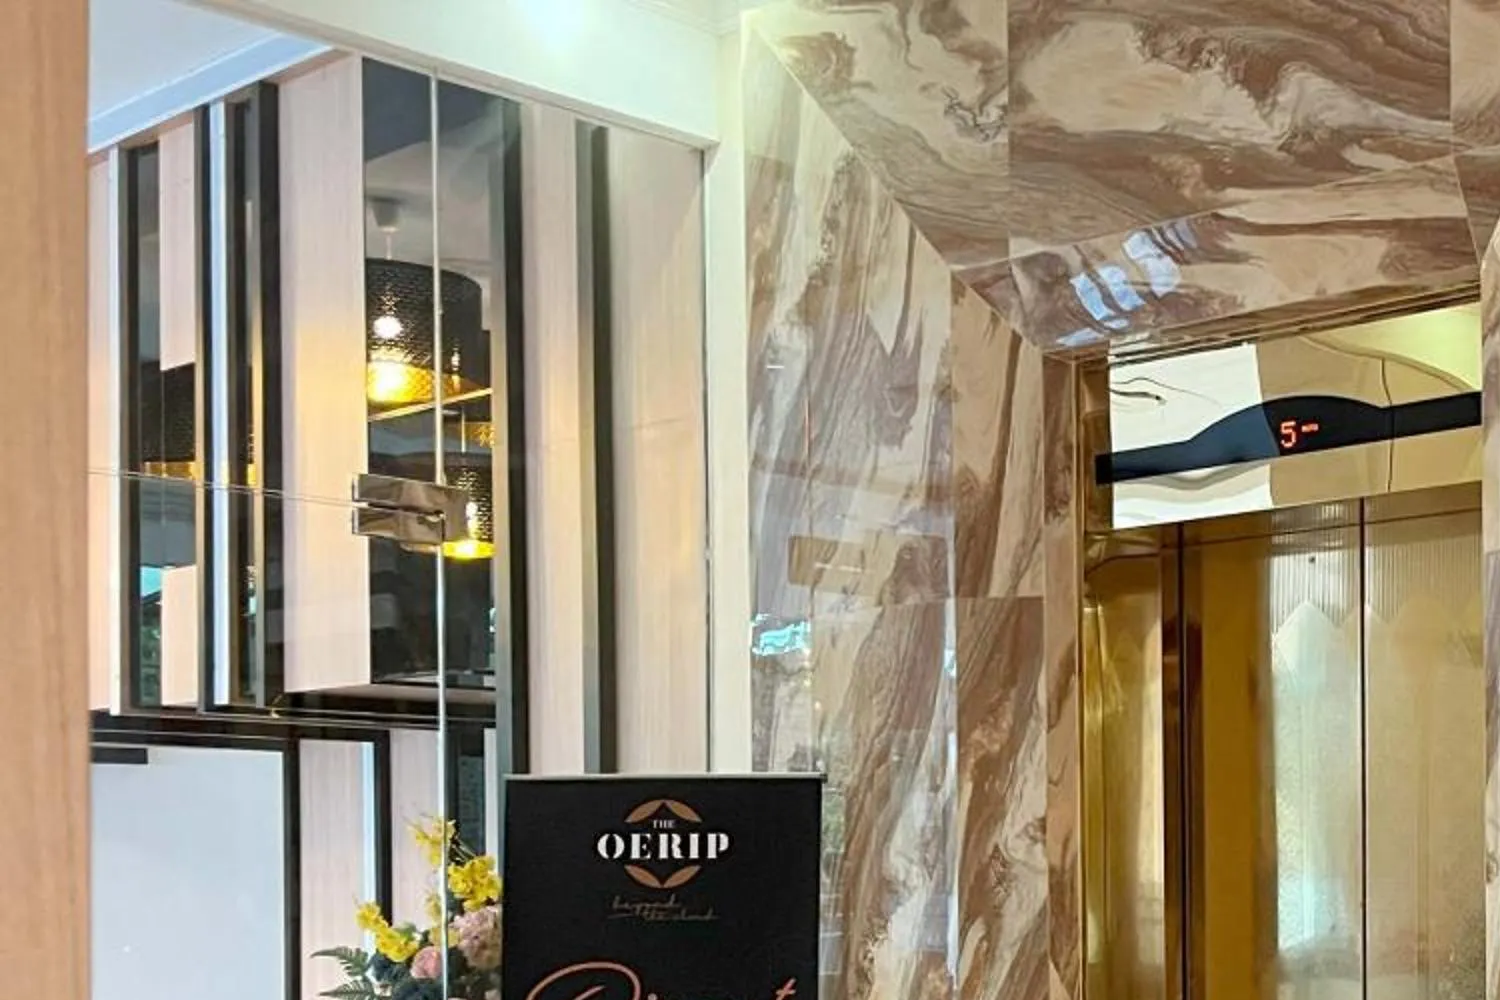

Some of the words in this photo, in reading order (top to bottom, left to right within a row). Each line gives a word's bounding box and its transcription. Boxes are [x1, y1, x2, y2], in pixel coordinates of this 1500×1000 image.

[1281, 420, 1297, 449] 5
[652, 819, 675, 829] THE
[597, 832, 729, 860] OERIP
